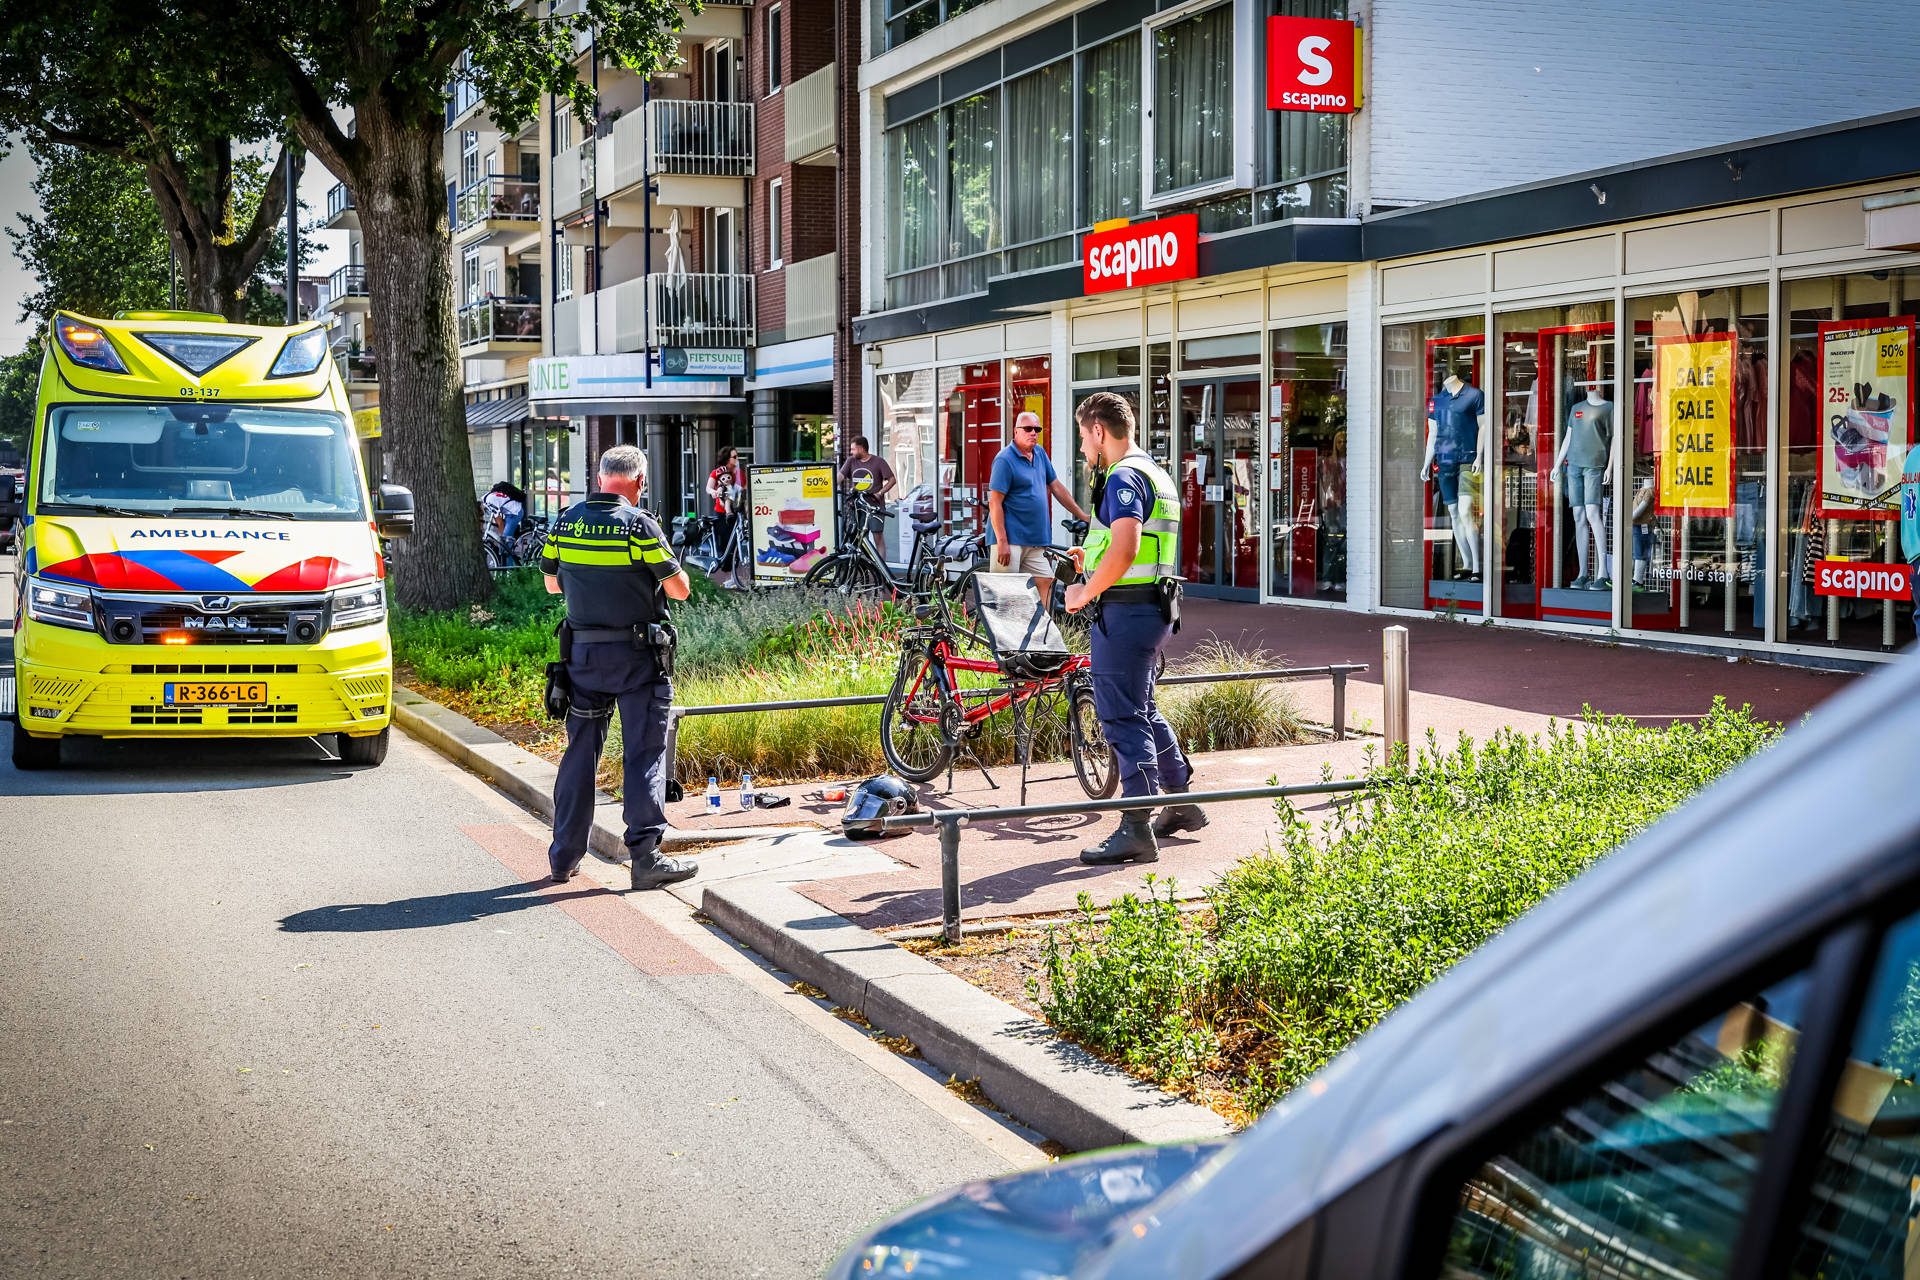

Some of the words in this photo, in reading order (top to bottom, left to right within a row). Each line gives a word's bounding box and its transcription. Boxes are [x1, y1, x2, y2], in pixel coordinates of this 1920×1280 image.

[1296, 35, 1333, 86] S
[1282, 92, 1347, 110] scapino
[1089, 231, 1179, 288] scapino
[689, 353, 743, 362] FIETSUNIE
[1881, 344, 1904, 358] 50%
[1676, 366, 1714, 387] SALE
[180, 387, 220, 397] 03-137
[1677, 399, 1714, 420] SALE
[1676, 433, 1714, 453] SALE
[806, 477, 829, 487] 50%
[1675, 466, 1713, 486] SALE
[130, 529, 291, 541] AMBULANCE
[567, 519, 621, 537] POLITIE
[1652, 566, 1682, 580] neem
[1686, 568, 1704, 582] die
[1708, 571, 1734, 588] stap
[1821, 568, 1905, 598] scapino
[184, 616, 249, 629] MAN
[180, 686, 258, 701] R-366-LG
